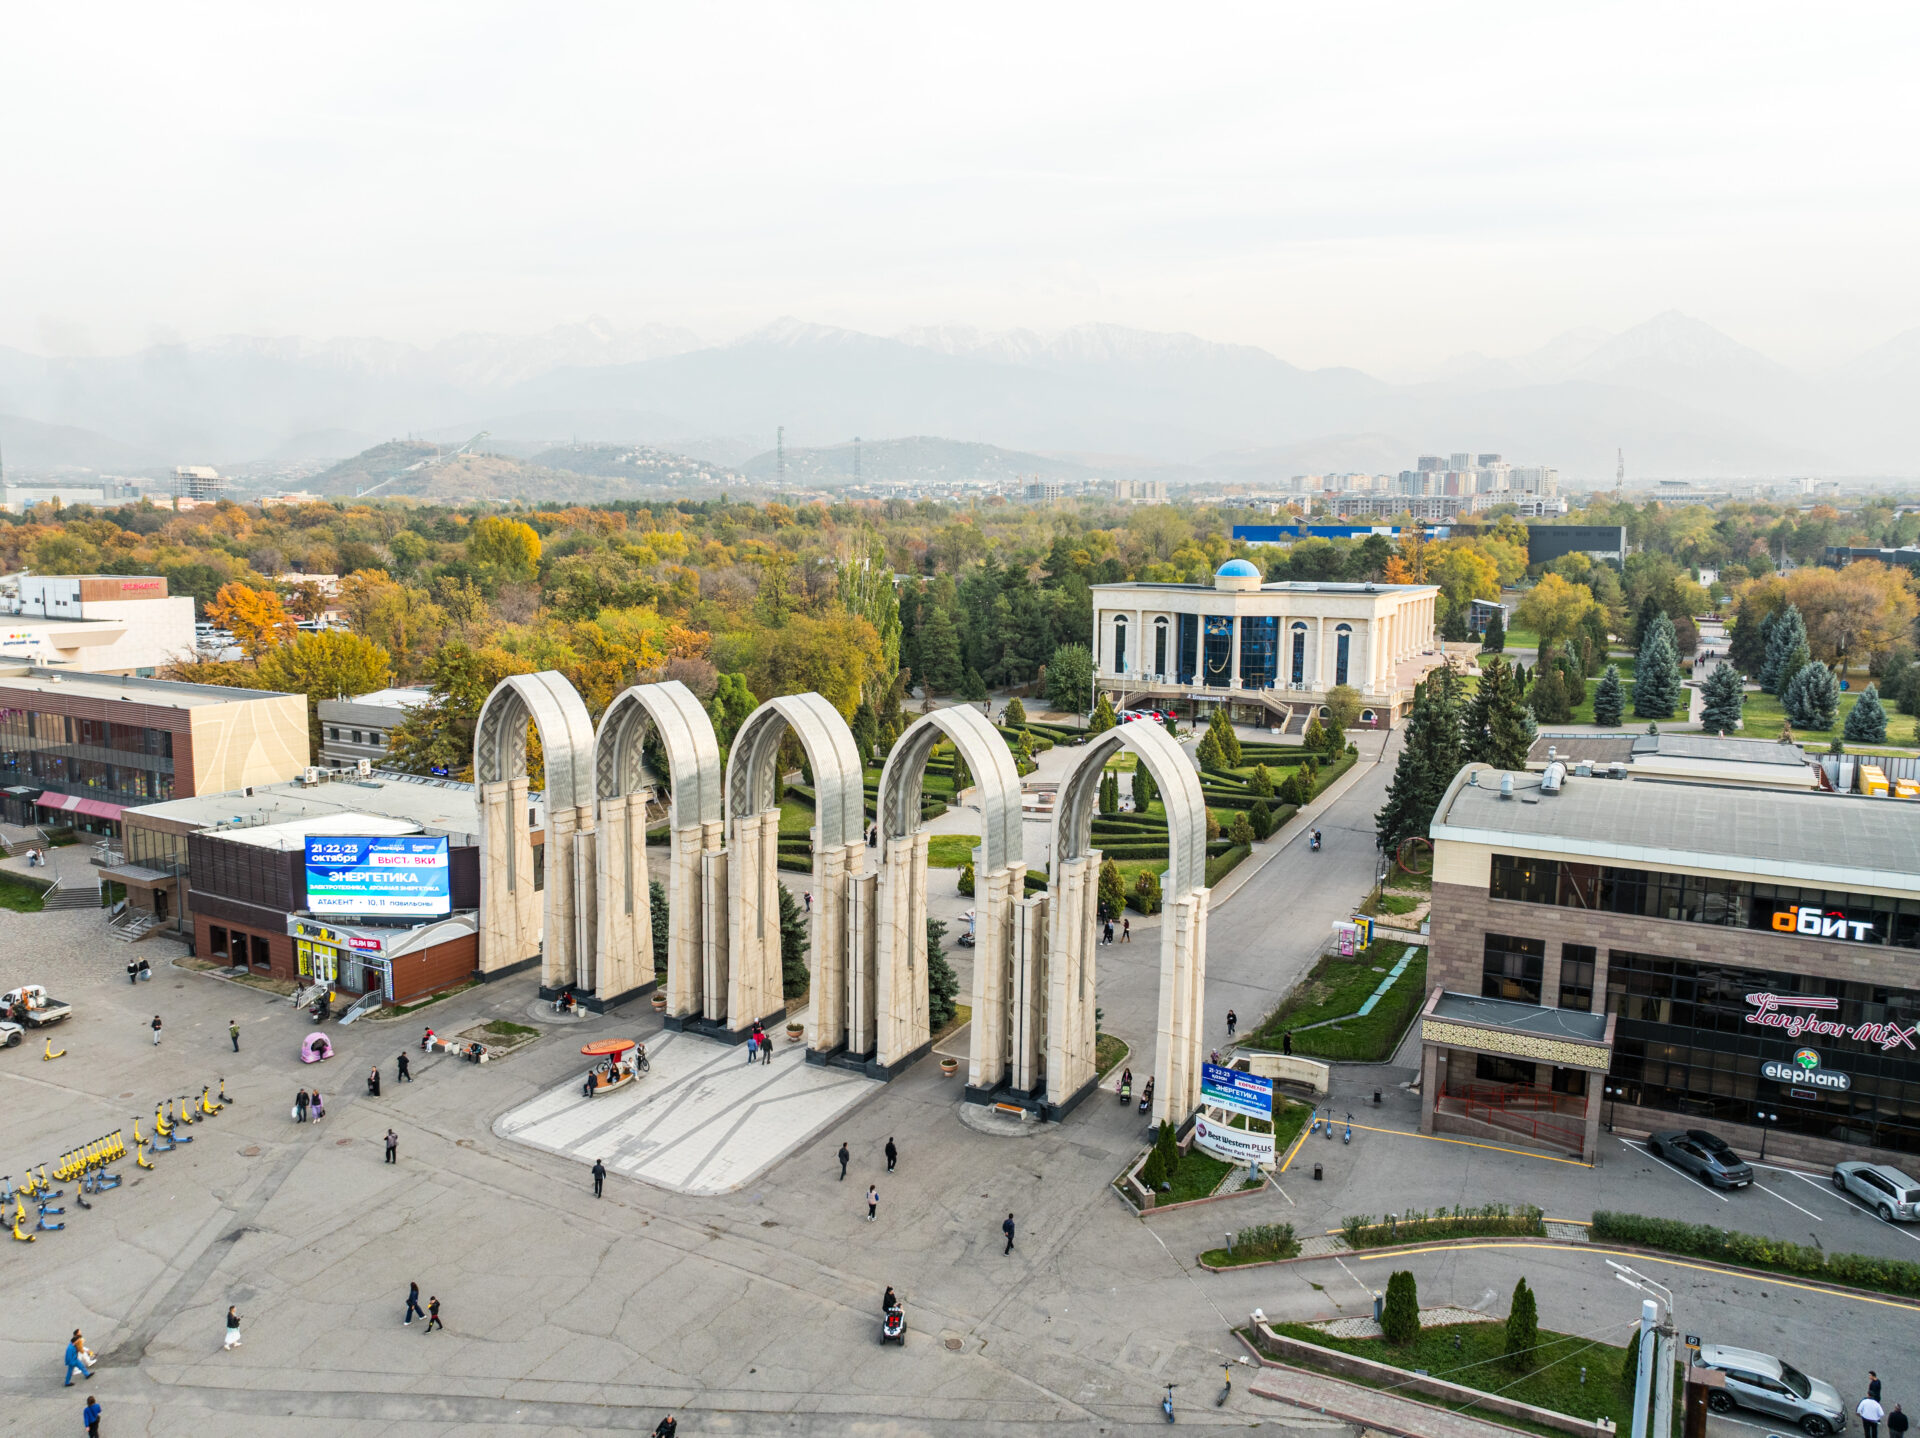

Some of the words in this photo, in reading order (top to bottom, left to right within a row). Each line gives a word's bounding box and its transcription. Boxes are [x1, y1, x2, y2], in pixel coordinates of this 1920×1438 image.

[312, 854, 357, 863] октября
[378, 856, 436, 864] ВЫСТВКИ
[329, 872, 418, 882] ЭНЕРГЕТИКА
[1765, 1064, 1846, 1089] elephant
[1215, 1084, 1258, 1101] ЭНЕРГЕТИКА
[1208, 1131, 1221, 1142] Best
[1222, 1136, 1250, 1149] Western
[1251, 1144, 1272, 1152] PLUS
